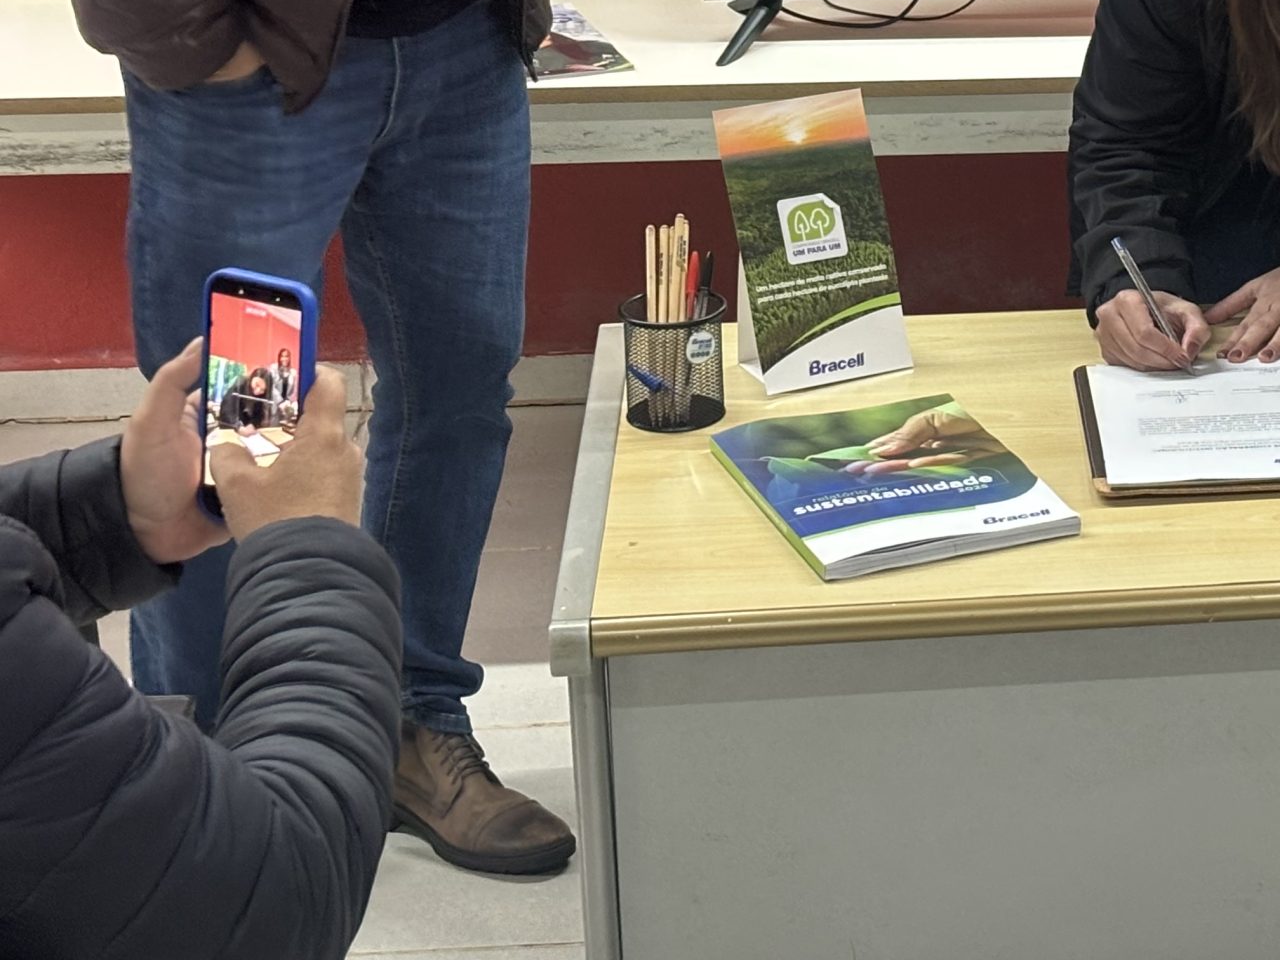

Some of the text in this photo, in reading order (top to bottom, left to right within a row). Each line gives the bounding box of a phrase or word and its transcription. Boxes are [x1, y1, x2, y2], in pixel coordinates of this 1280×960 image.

[792, 248, 806, 257] UM
[807, 245, 827, 255] PARA
[828, 242, 841, 251] UM
[809, 352, 865, 376] Bracell
[792, 474, 994, 516] sustentabilidade
[982, 507, 1052, 526] Bracell
